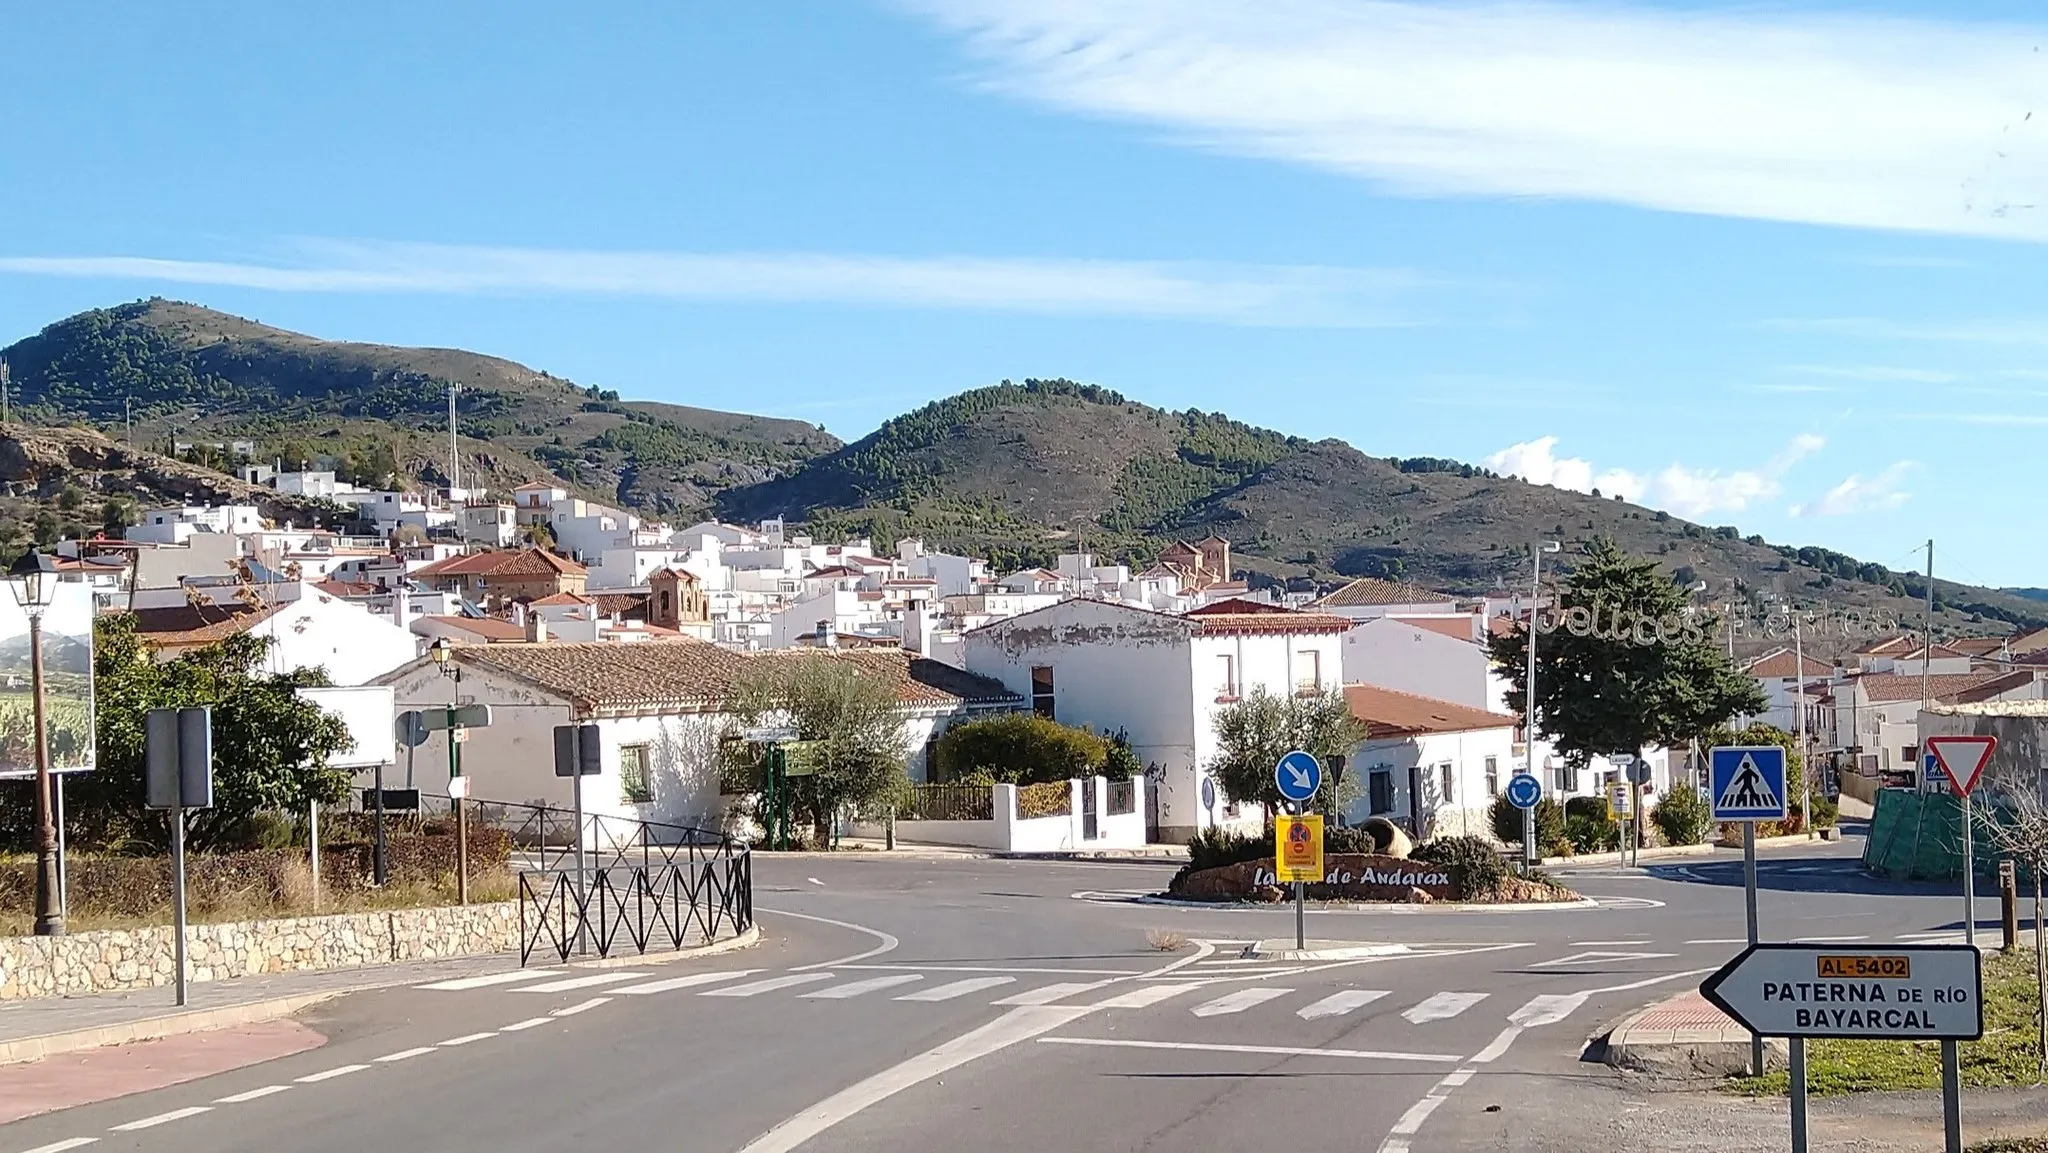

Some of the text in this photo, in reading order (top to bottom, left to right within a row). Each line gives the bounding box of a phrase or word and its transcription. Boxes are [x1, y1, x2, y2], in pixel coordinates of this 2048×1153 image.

[1326, 867, 1350, 885] de
[1360, 866, 1449, 886] Andarax
[1820, 959, 1907, 975] AL-5402
[1763, 982, 1967, 1003] PATERNA DE RÍO
[1795, 1009, 1936, 1029] BAYARCAL
